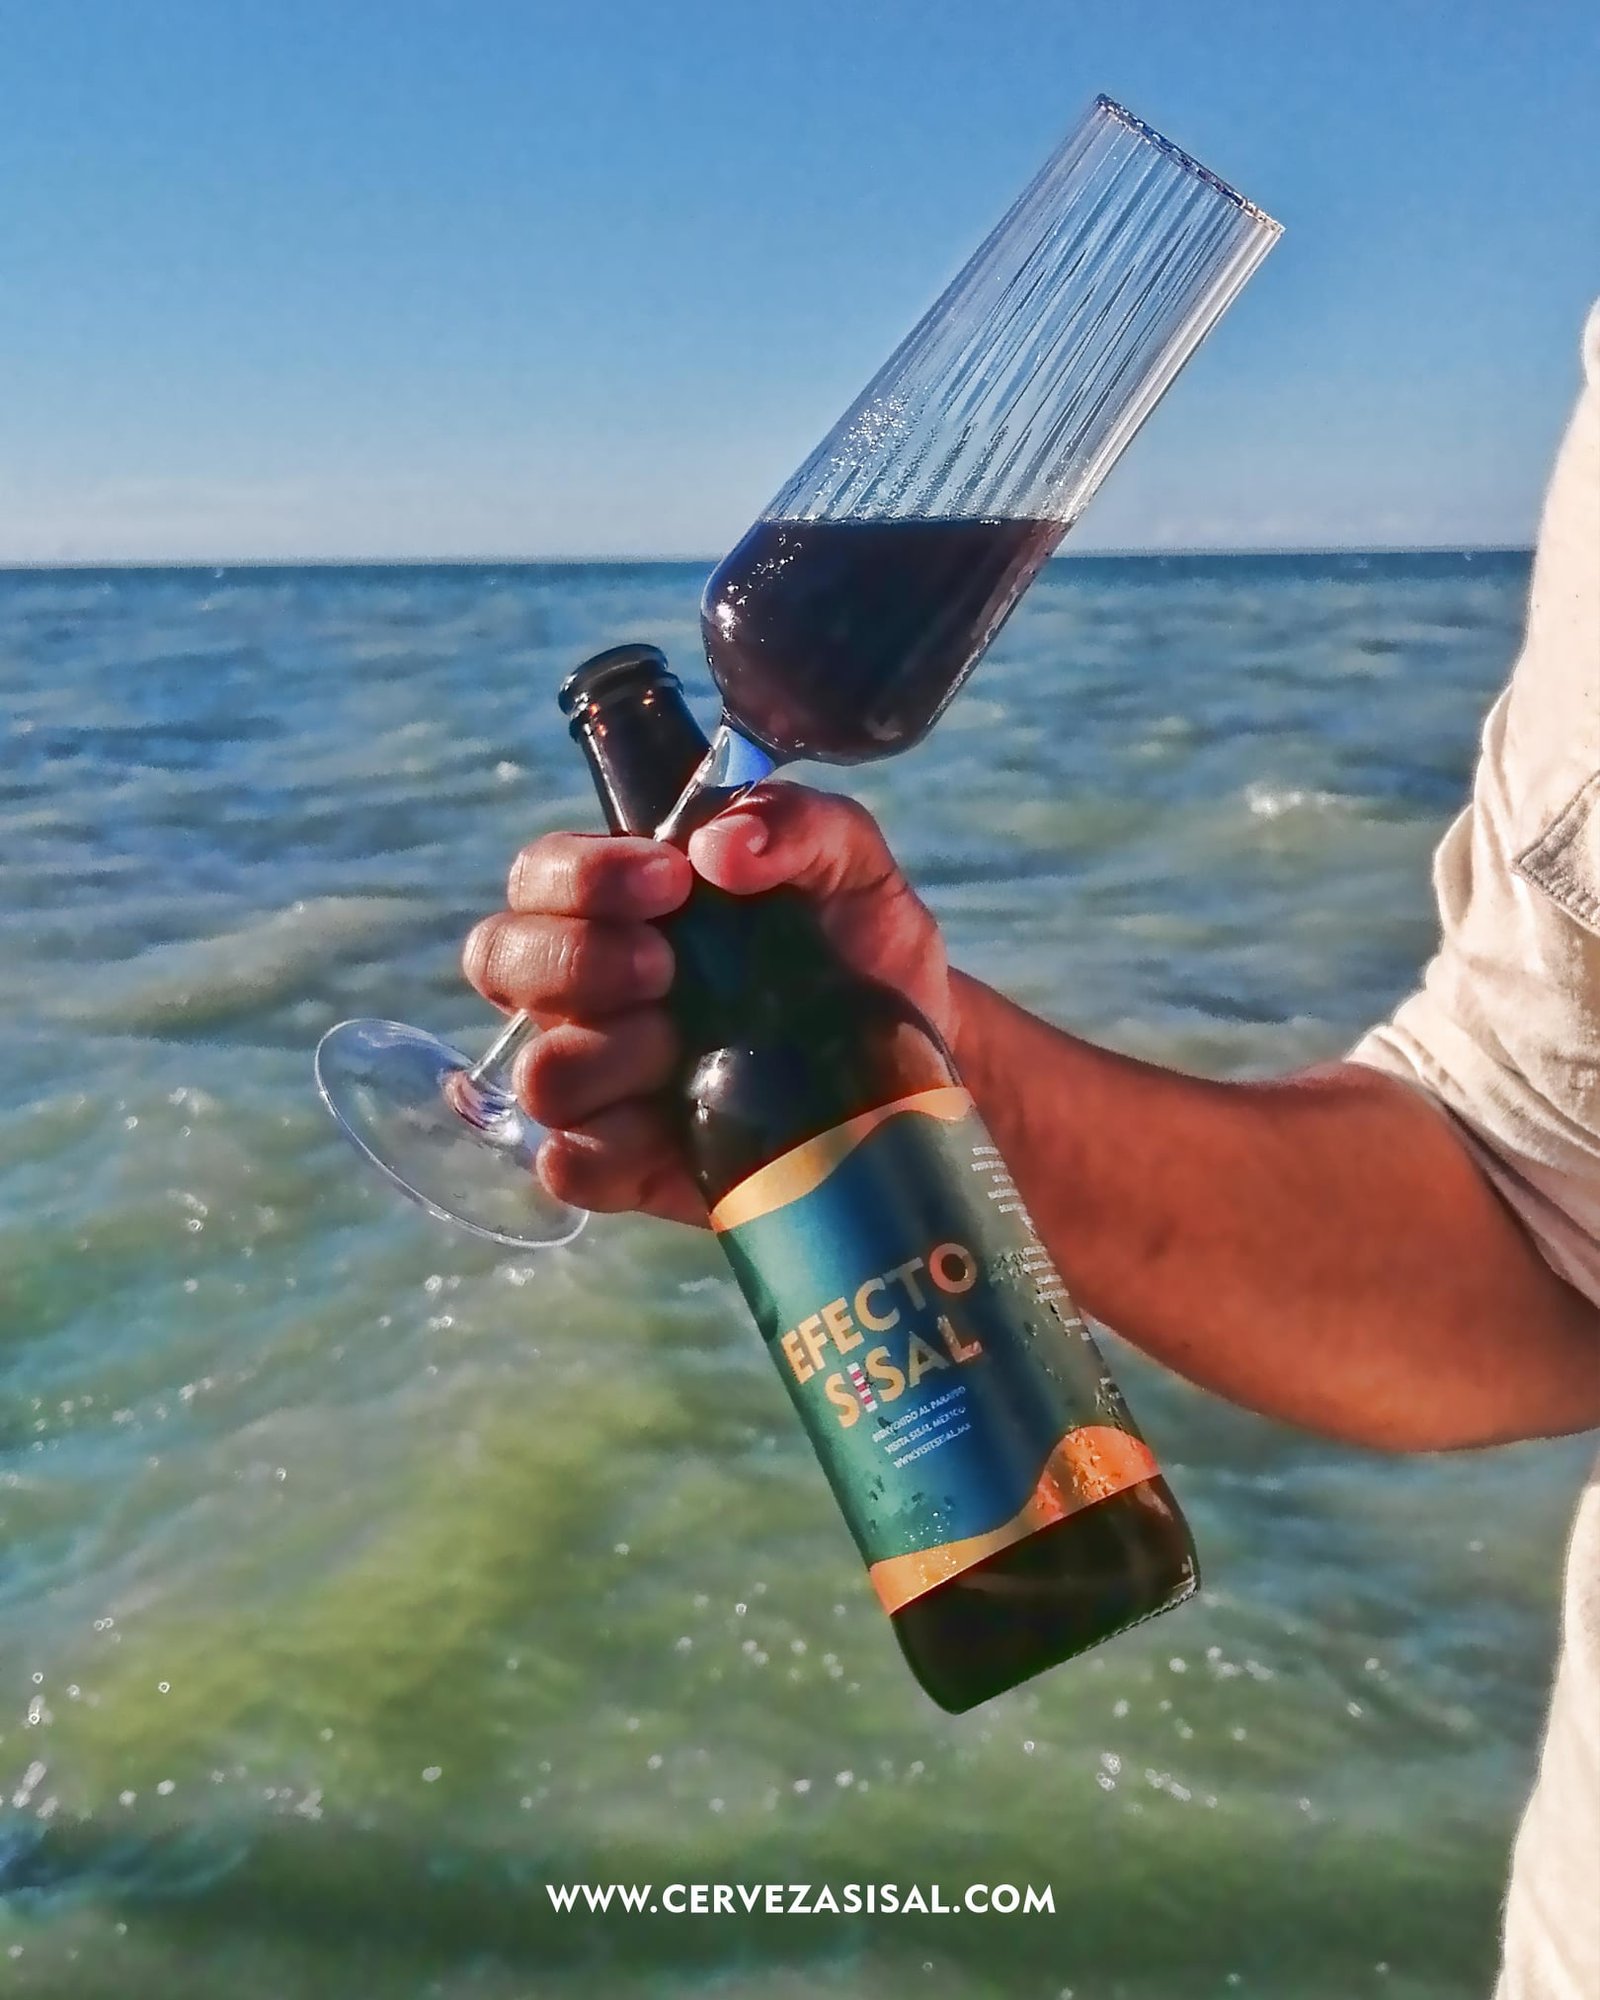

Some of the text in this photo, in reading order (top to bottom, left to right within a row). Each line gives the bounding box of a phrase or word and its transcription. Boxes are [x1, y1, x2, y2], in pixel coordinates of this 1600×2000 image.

[781, 1242, 977, 1384] EFECTO
[825, 1314, 984, 1428] SISAL
[919, 1405, 931, 1417] AL
